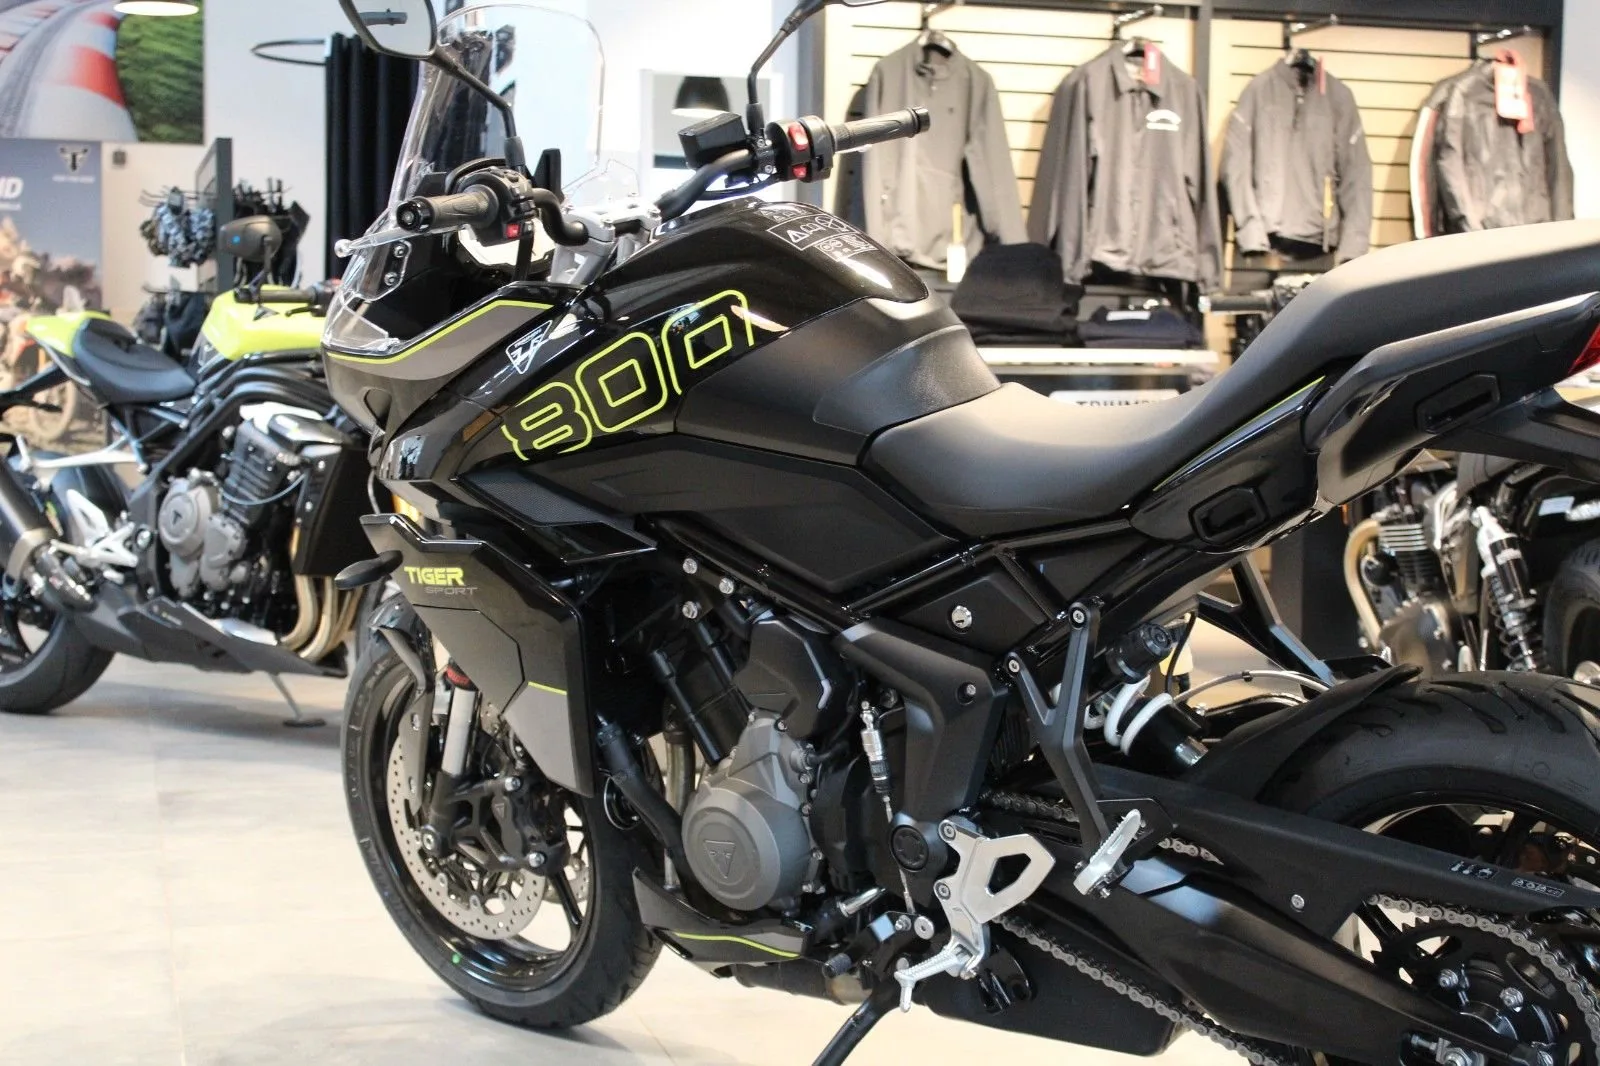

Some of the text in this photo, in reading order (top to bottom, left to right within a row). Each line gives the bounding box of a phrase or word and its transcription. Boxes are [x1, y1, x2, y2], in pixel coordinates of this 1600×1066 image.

[501, 290, 754, 461] 800
[403, 566, 465, 586] TIGER
[425, 586, 478, 595] SPORT
